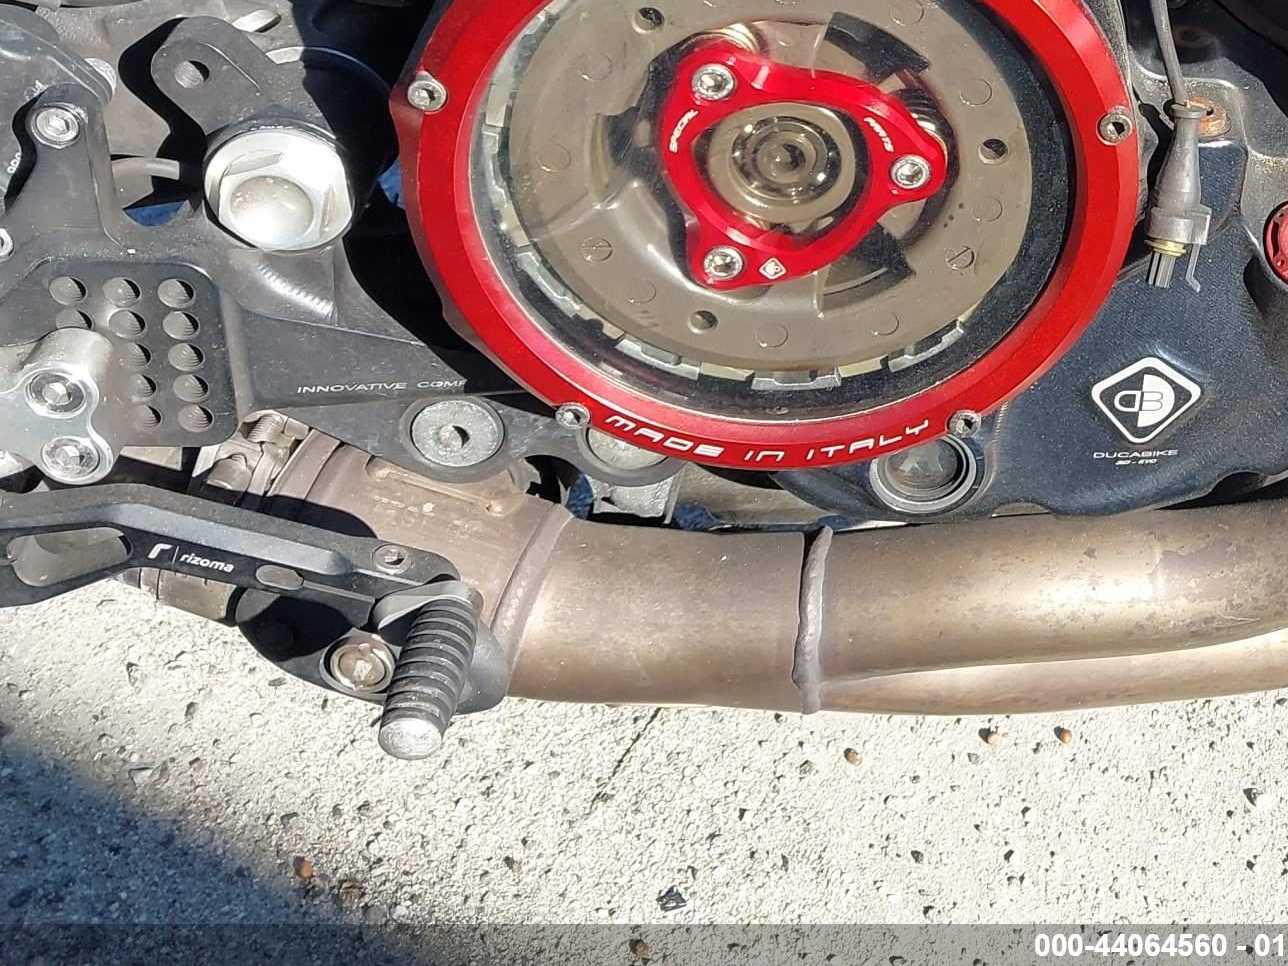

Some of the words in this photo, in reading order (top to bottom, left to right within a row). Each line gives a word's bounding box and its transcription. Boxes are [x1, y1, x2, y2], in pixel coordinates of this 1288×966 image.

[864, 116, 895, 153] PARTS
[297, 382, 409, 394] INNOVATIVE
[604, 414, 726, 458] MADE
[744, 450, 785, 462] IN
[806, 419, 930, 460] ITALY
[1092, 449, 1179, 459] DUCABIKE
[179, 553, 235, 573] rizoma
